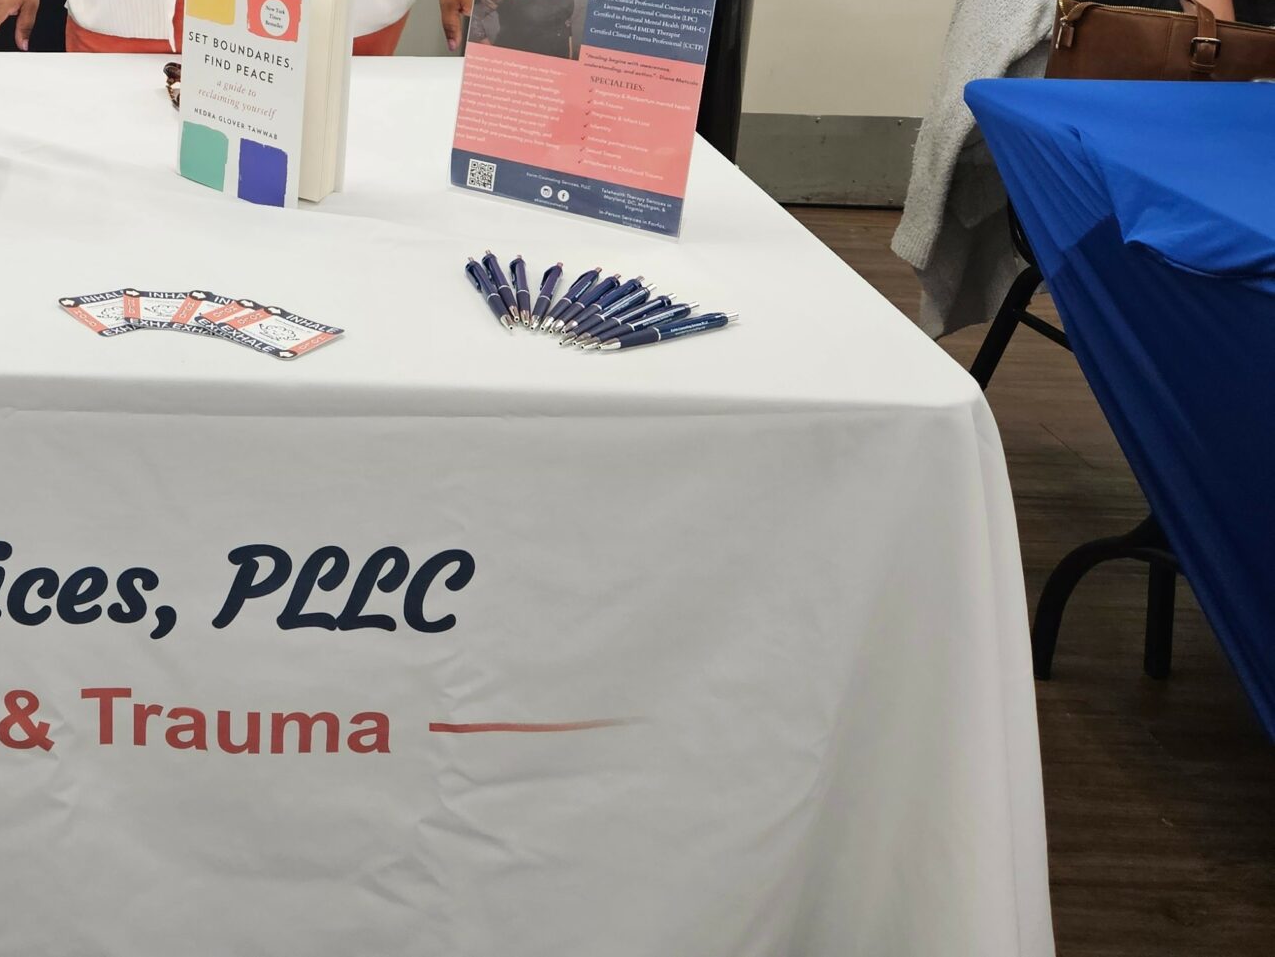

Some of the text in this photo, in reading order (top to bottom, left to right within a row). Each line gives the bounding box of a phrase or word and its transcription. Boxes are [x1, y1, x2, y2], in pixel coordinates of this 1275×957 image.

[188, 31, 294, 71] SET BOUNDARIES,
[204, 54, 274, 84] FIND PEACE
[198, 88, 277, 121] reclaiming yourself
[223, 82, 245, 95] guide
[247, 89, 257, 97] to
[194, 107, 278, 140] NEDRA GLOVER TAWWAB
[222, 325, 276, 353] EXHALE
[285, 314, 340, 334] INHALE
[212, 543, 476, 634] PLLC
[81, 687, 392, 755] Trauma
